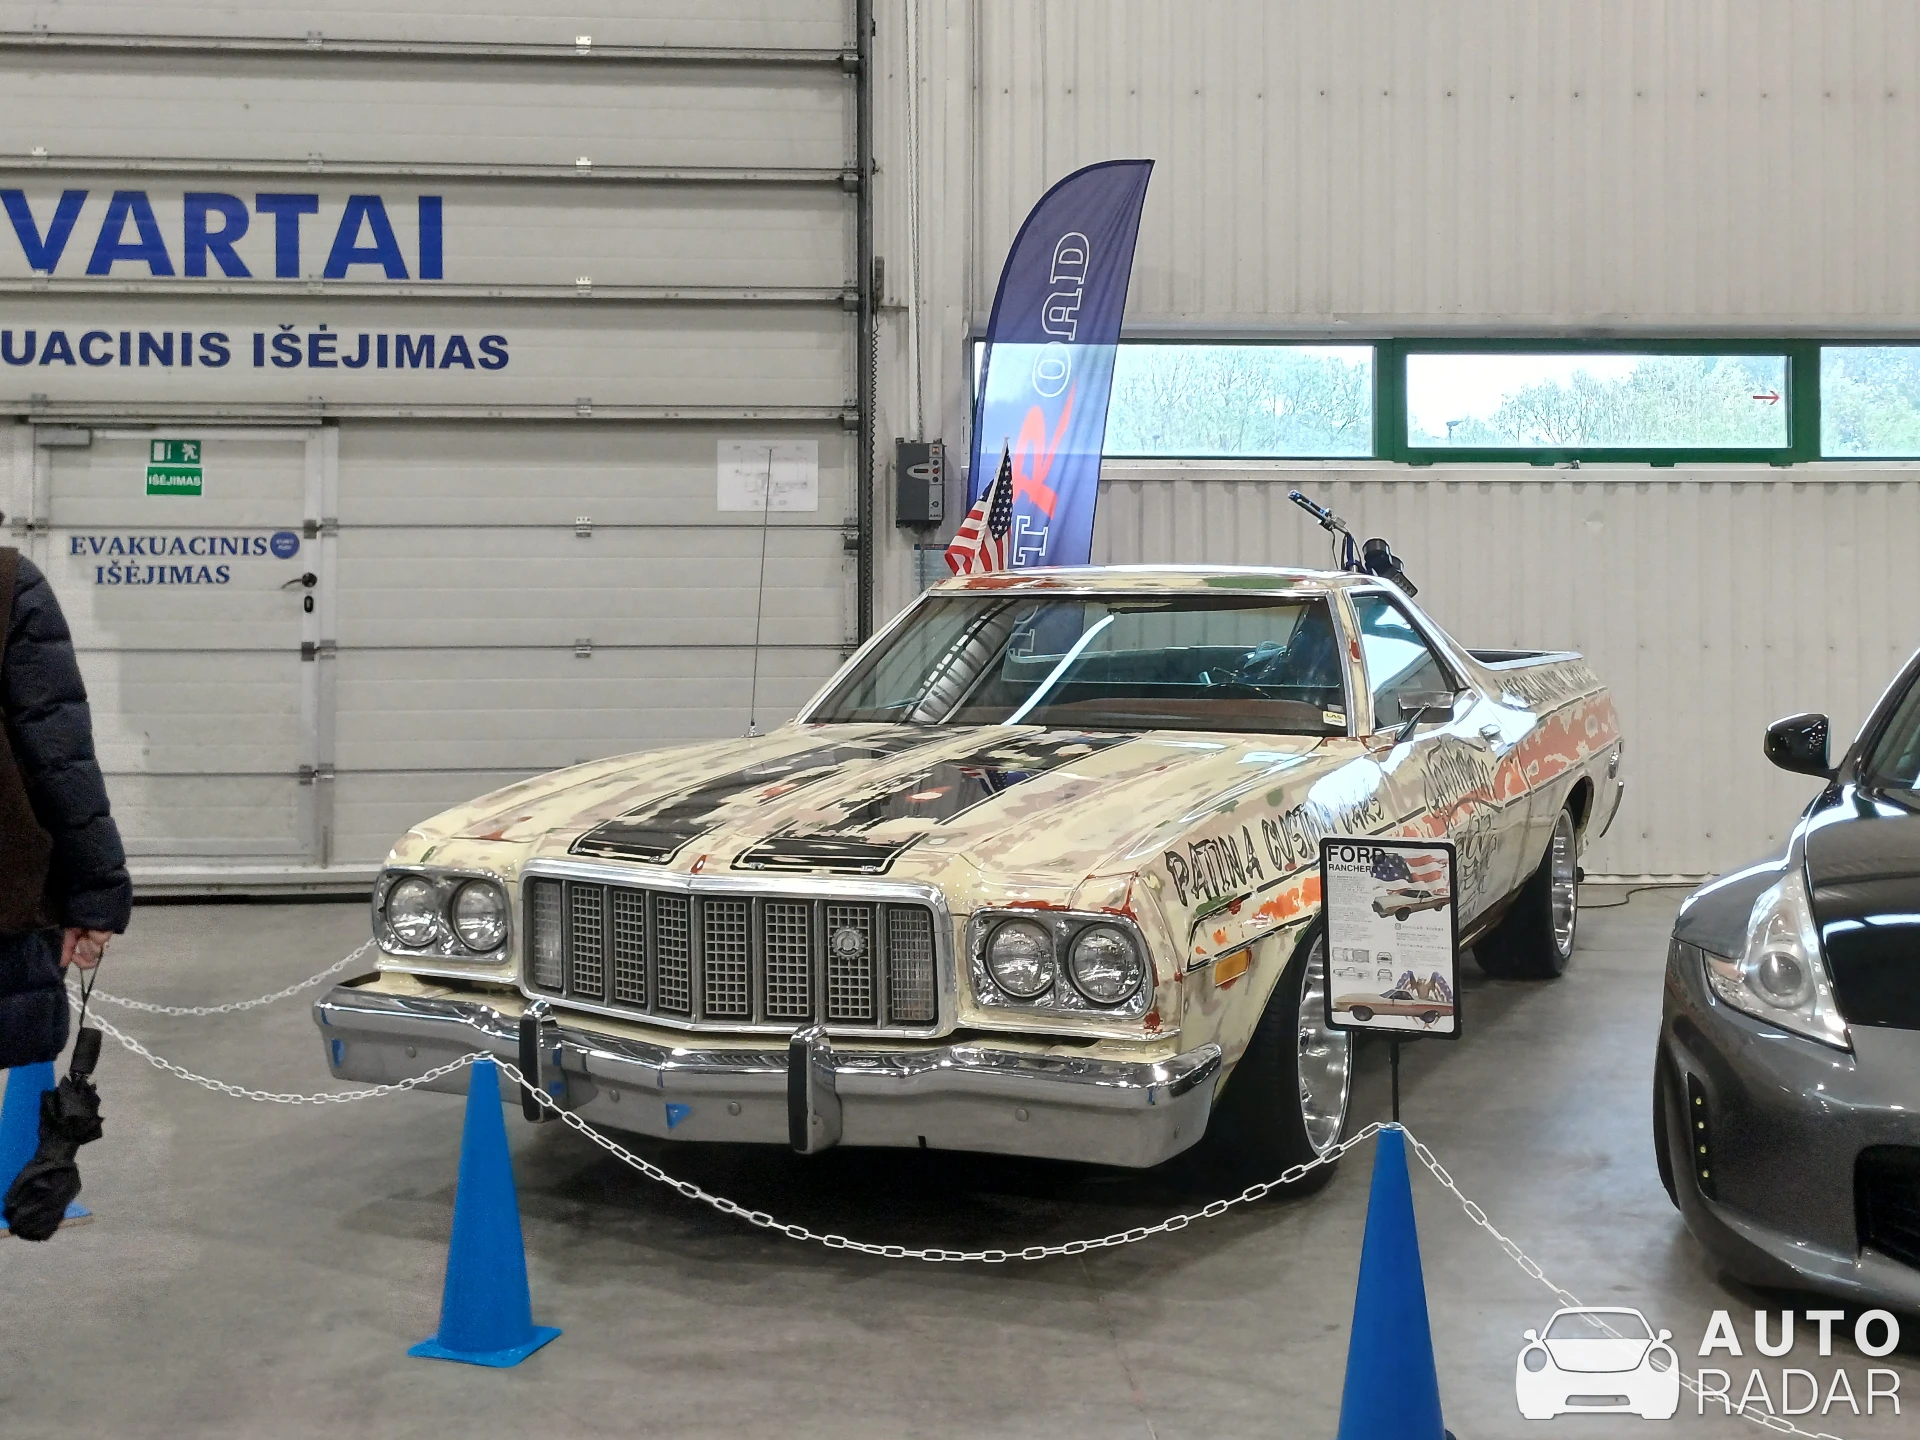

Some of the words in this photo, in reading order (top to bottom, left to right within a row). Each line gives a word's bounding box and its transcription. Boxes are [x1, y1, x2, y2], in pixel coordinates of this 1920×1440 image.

[0, 188, 443, 280] VARTAI
[1, 330, 231, 368] UACINIS
[253, 324, 509, 370] IŠĖJIMAS
[148, 474, 201, 486] IŠĖJIMAS
[70, 536, 267, 556] EVAKUACINIS
[95, 560, 230, 585] IŠĖJIMAS
[1164, 824, 1264, 907] PATINA
[1328, 846, 1386, 864] FORD
[1328, 863, 1372, 873] RANCHER
